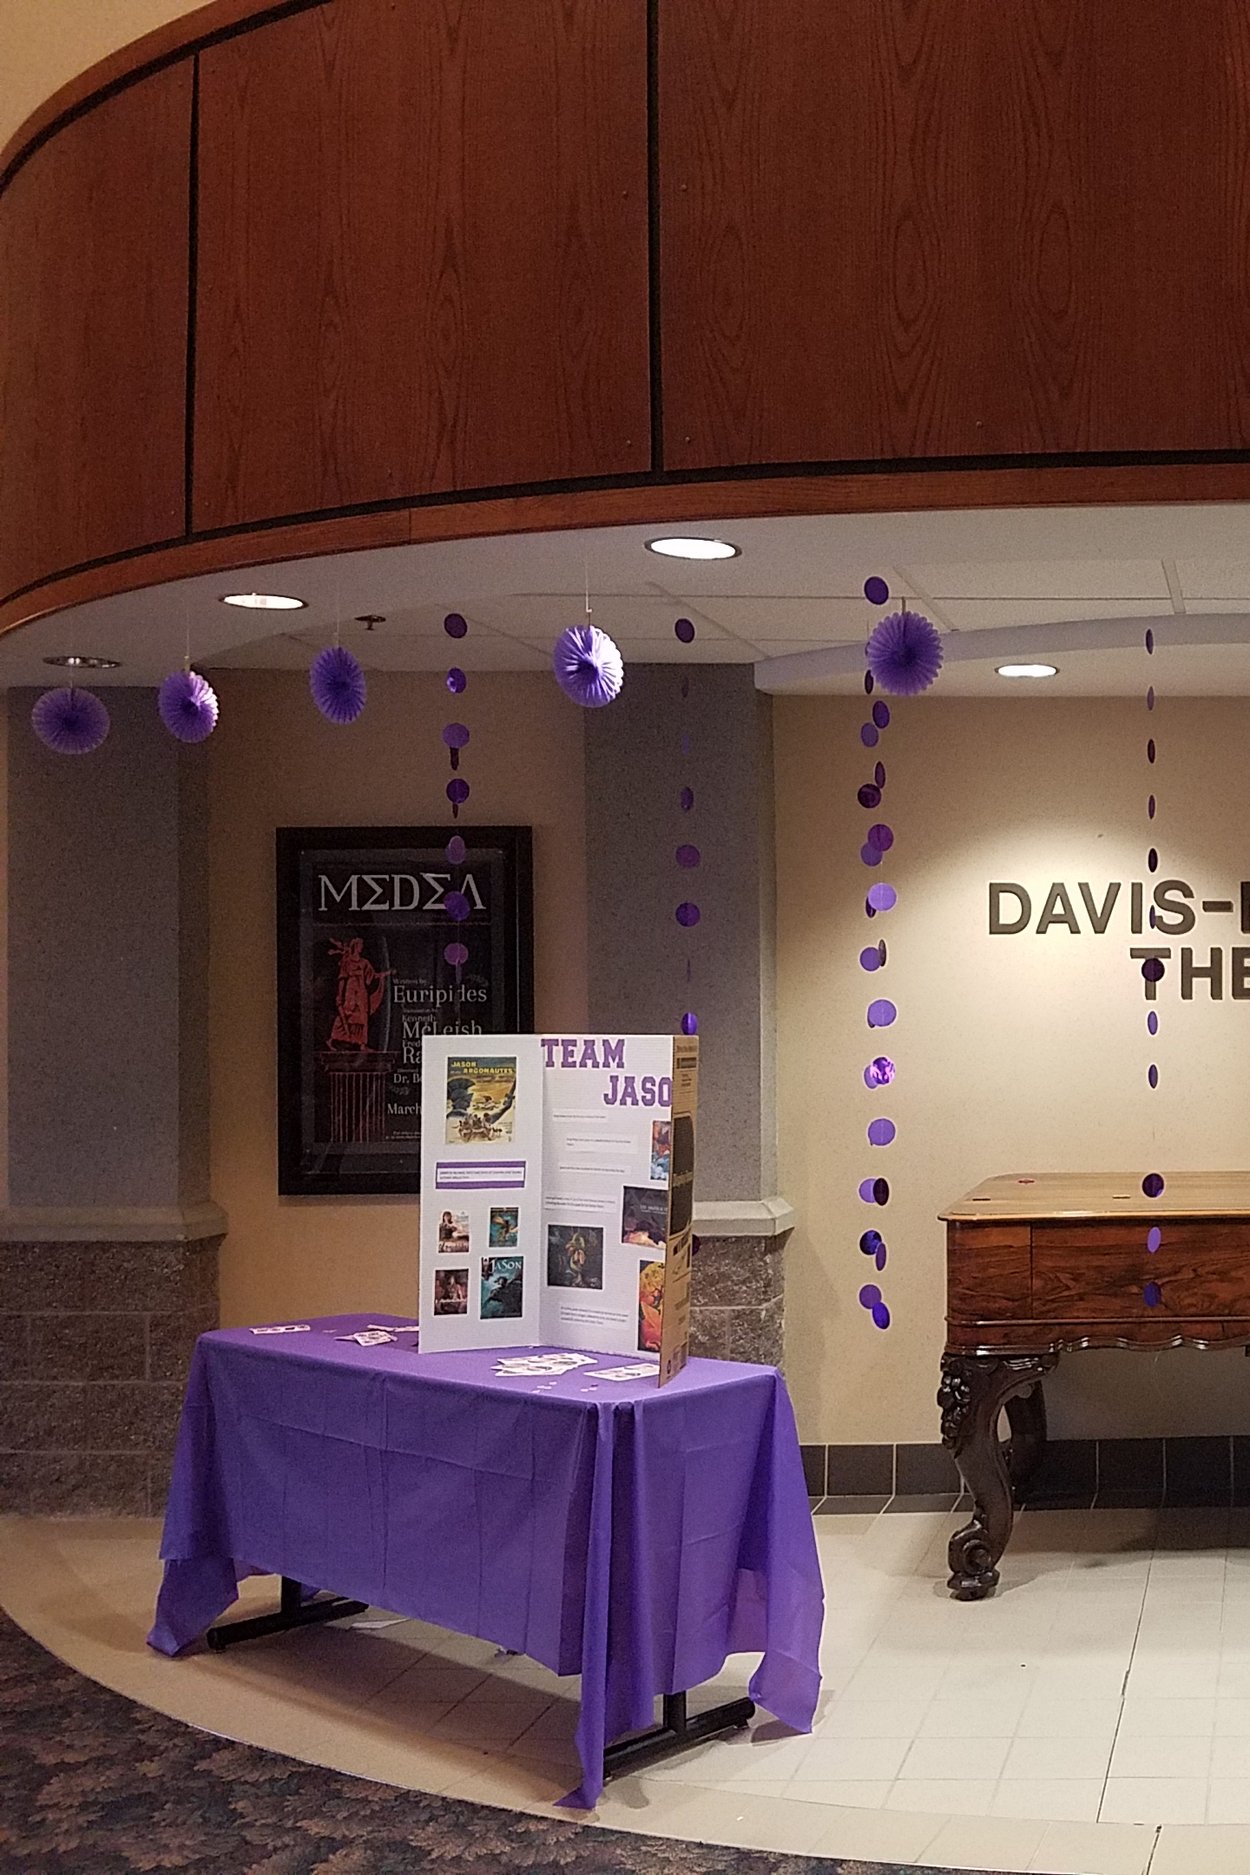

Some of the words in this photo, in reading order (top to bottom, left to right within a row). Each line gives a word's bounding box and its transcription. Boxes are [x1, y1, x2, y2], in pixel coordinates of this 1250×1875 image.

[394, 984, 488, 1007] Euripides
[541, 1039, 626, 1069] TEAM
[393, 1073, 410, 1084] Dr.
[492, 1259, 522, 1273] JASON
